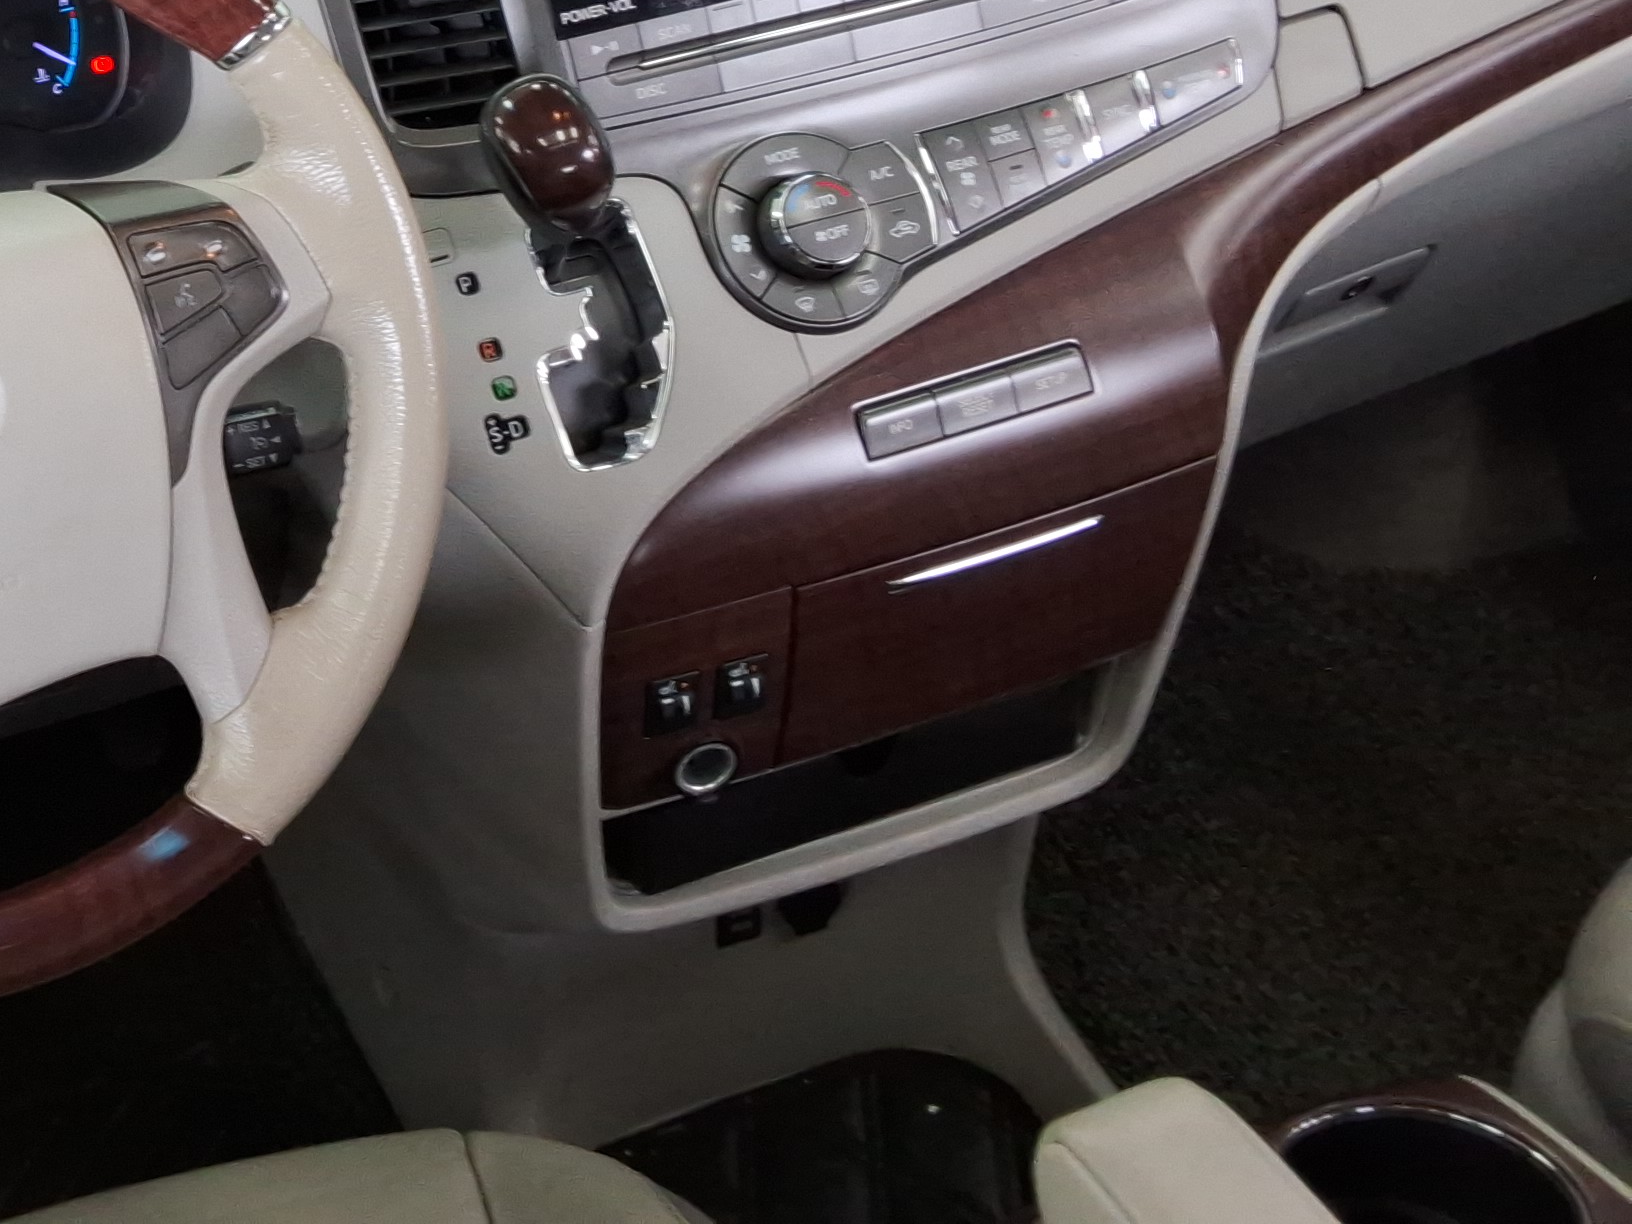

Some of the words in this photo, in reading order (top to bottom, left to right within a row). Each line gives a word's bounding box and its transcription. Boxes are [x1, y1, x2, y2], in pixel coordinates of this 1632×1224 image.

[52, 83, 63, 94] C
[635, 83, 667, 99] DISC
[764, 147, 801, 165] MODE
[945, 156, 979, 172] REAR
[869, 166, 895, 181] A/C
[804, 193, 838, 210] AUTO
[828, 224, 849, 240] OFF
[458, 276, 473, 293] P
[481, 342, 497, 360] R
